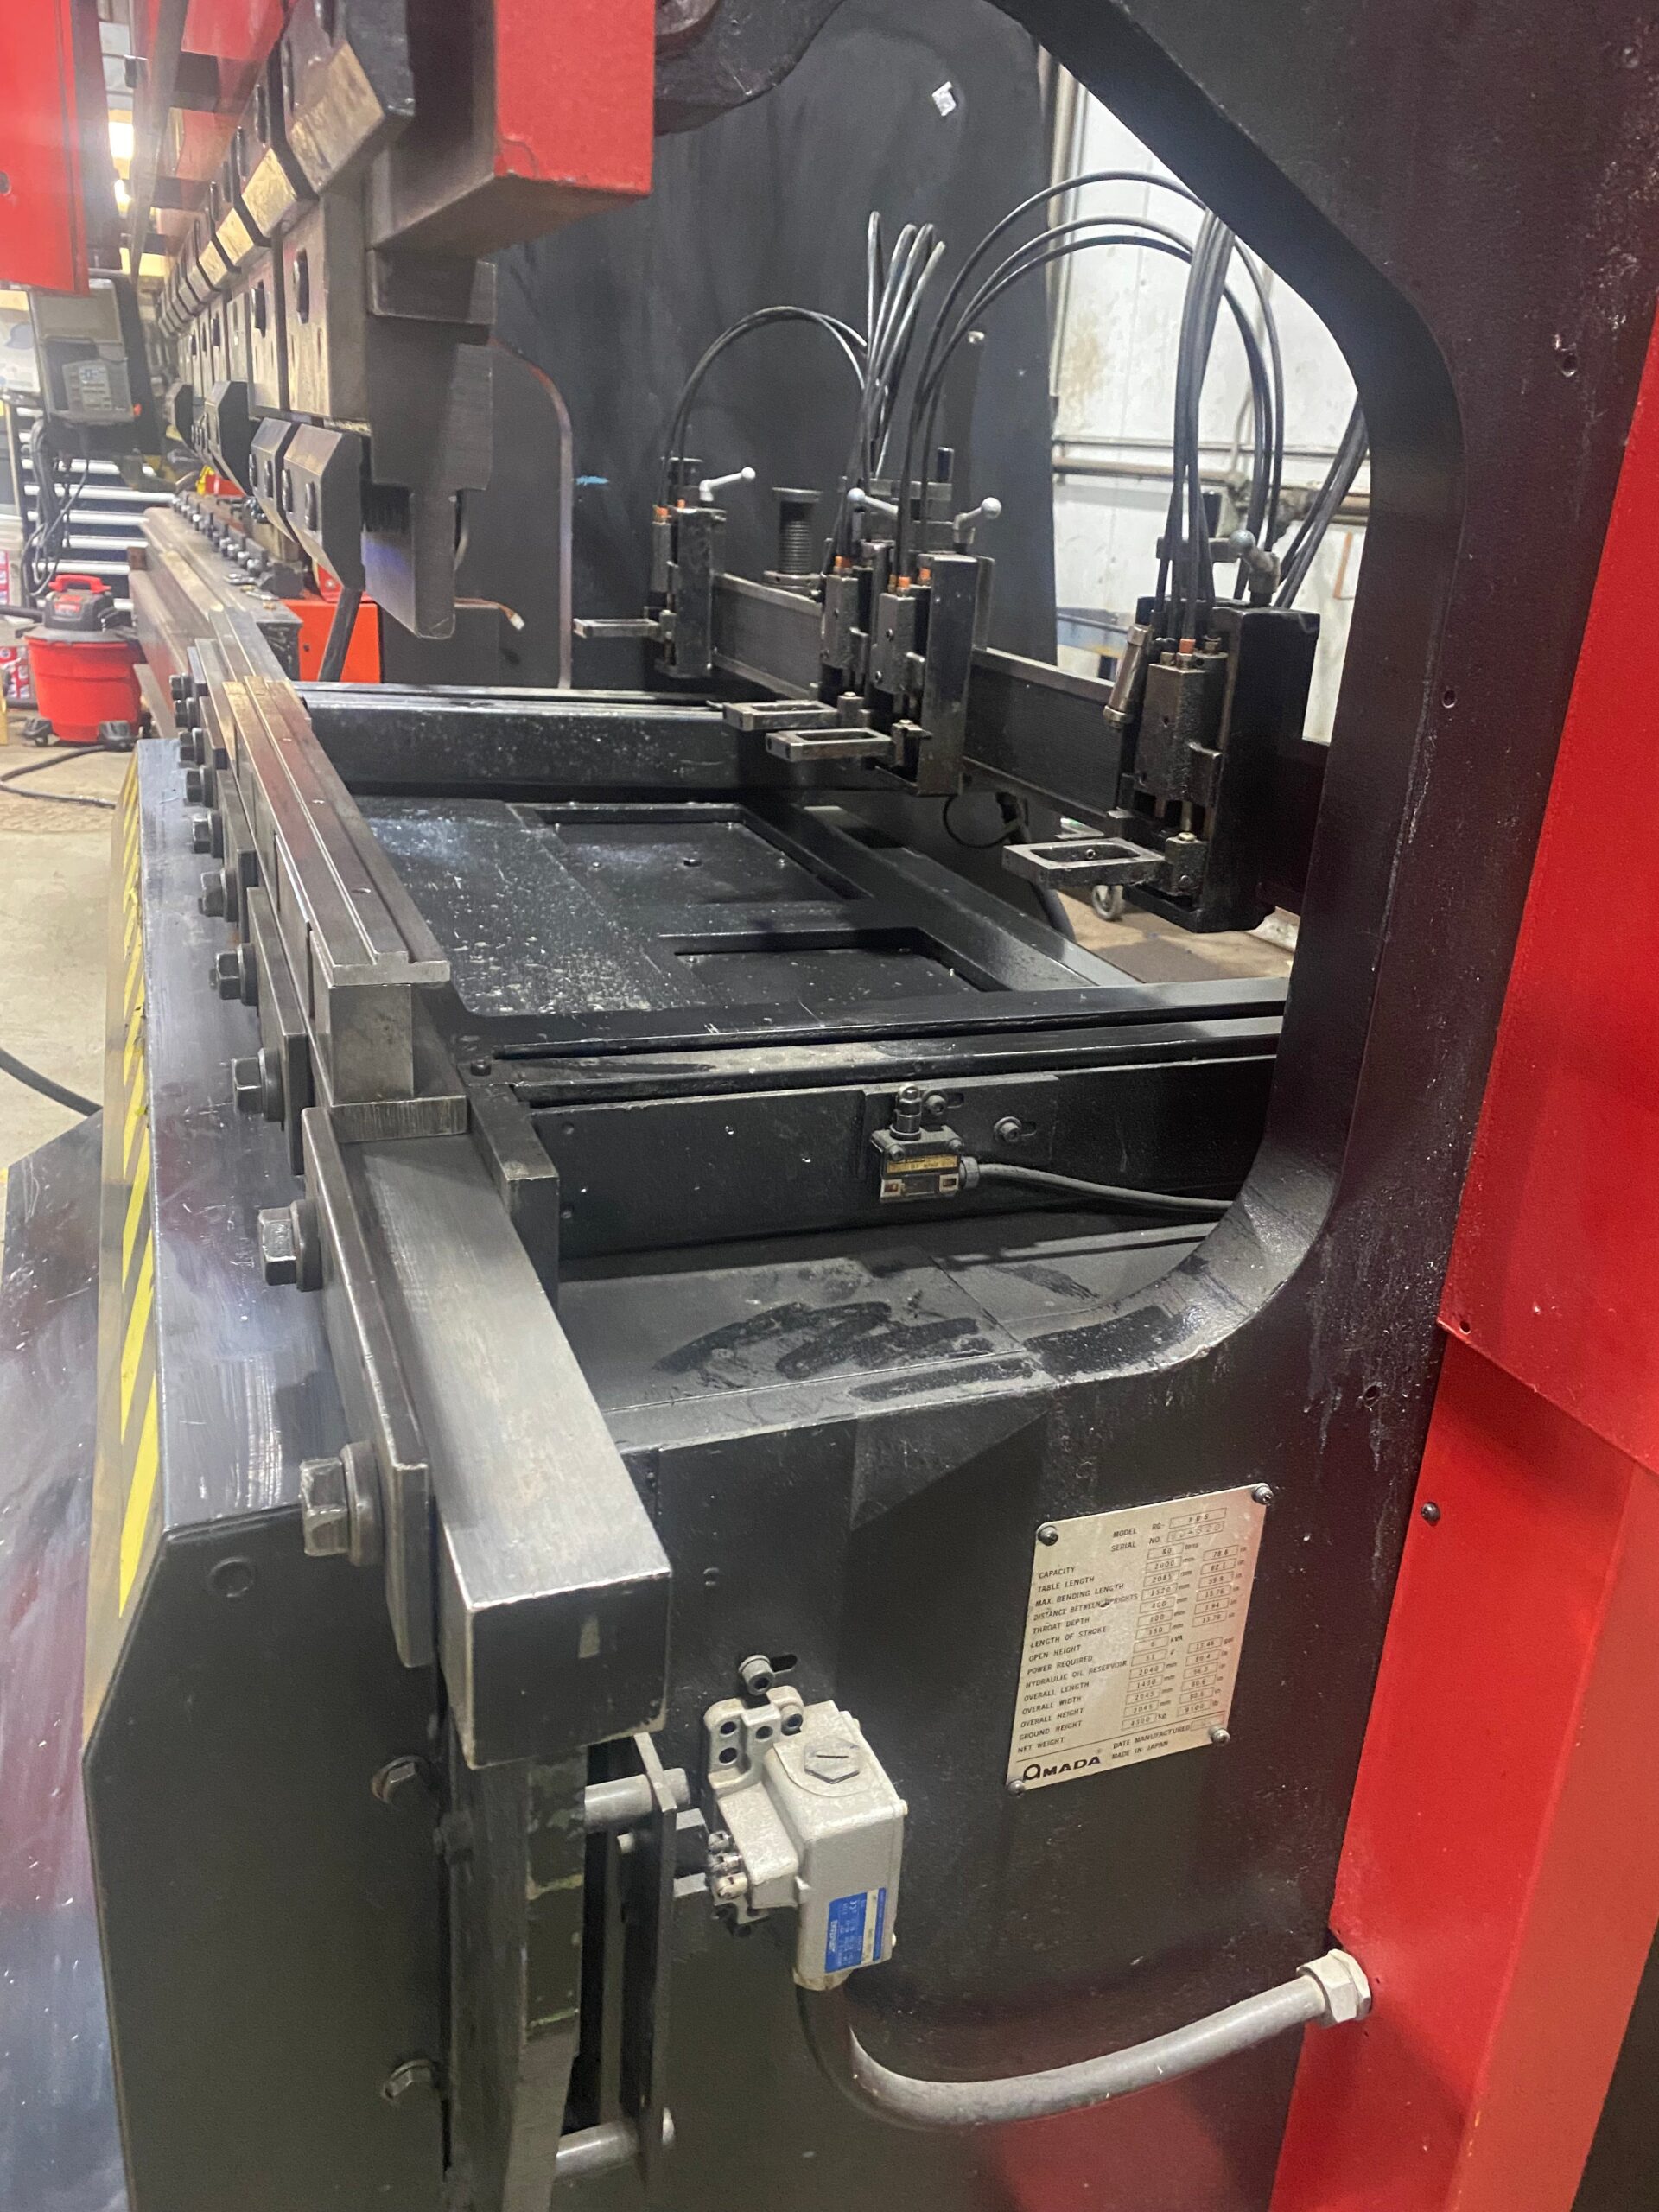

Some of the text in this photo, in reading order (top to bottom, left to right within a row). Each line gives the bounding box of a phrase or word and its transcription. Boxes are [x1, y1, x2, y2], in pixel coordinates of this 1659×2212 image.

[1113, 1528, 1137, 1538] MODEL
[1111, 1541, 1136, 1552] SERIAL
[1038, 1583, 1060, 1592] TABLE
[1065, 1576, 1094, 1587] LENGTH
[1154, 1560, 1174, 1569] 2000
[1039, 1567, 1075, 1579] CAPACITY
[1057, 1590, 1090, 1602] BENDING
[1095, 1584, 1124, 1594] LENGTH
[1034, 1609, 1066, 1621] DISTANCE
[1070, 1602, 1100, 1613] BETWEEN
[1033, 1623, 1061, 1634] THROAT
[1066, 1618, 1090, 1627] DEPTH
[1031, 1637, 1060, 1648] LENGTH
[1078, 1627, 1106, 1637] STROKE
[1029, 1652, 1050, 1662] OPEN
[1054, 1645, 1081, 1656] HEIGHT
[1027, 1675, 1067, 1688] HYDRAULIC
[1089, 1660, 1128, 1674] RESERVOIR
[1028, 1664, 1052, 1675] POWER
[1057, 1656, 1092, 1669] REQUIRED
[1024, 1689, 1056, 1701] OVERALL
[1061, 1681, 1090, 1693] LENGTH
[1023, 1703, 1054, 1715] OVERALL
[1059, 1696, 1082, 1707] WIDTH
[1021, 1716, 1052, 1728] OVERALL
[1058, 1708, 1084, 1719] HEIGHT
[1020, 1729, 1050, 1741] GROUND
[1055, 1721, 1082, 1732] HEIGHT
[1113, 1726, 1190, 1750] DATE MANUFACTURED
[1038, 1738, 1065, 1749] WEIGHT
[1112, 1751, 1132, 1760] MADE
[1147, 1741, 1168, 1751] JAPAN
[1023, 1756, 1100, 1782] AMADA
